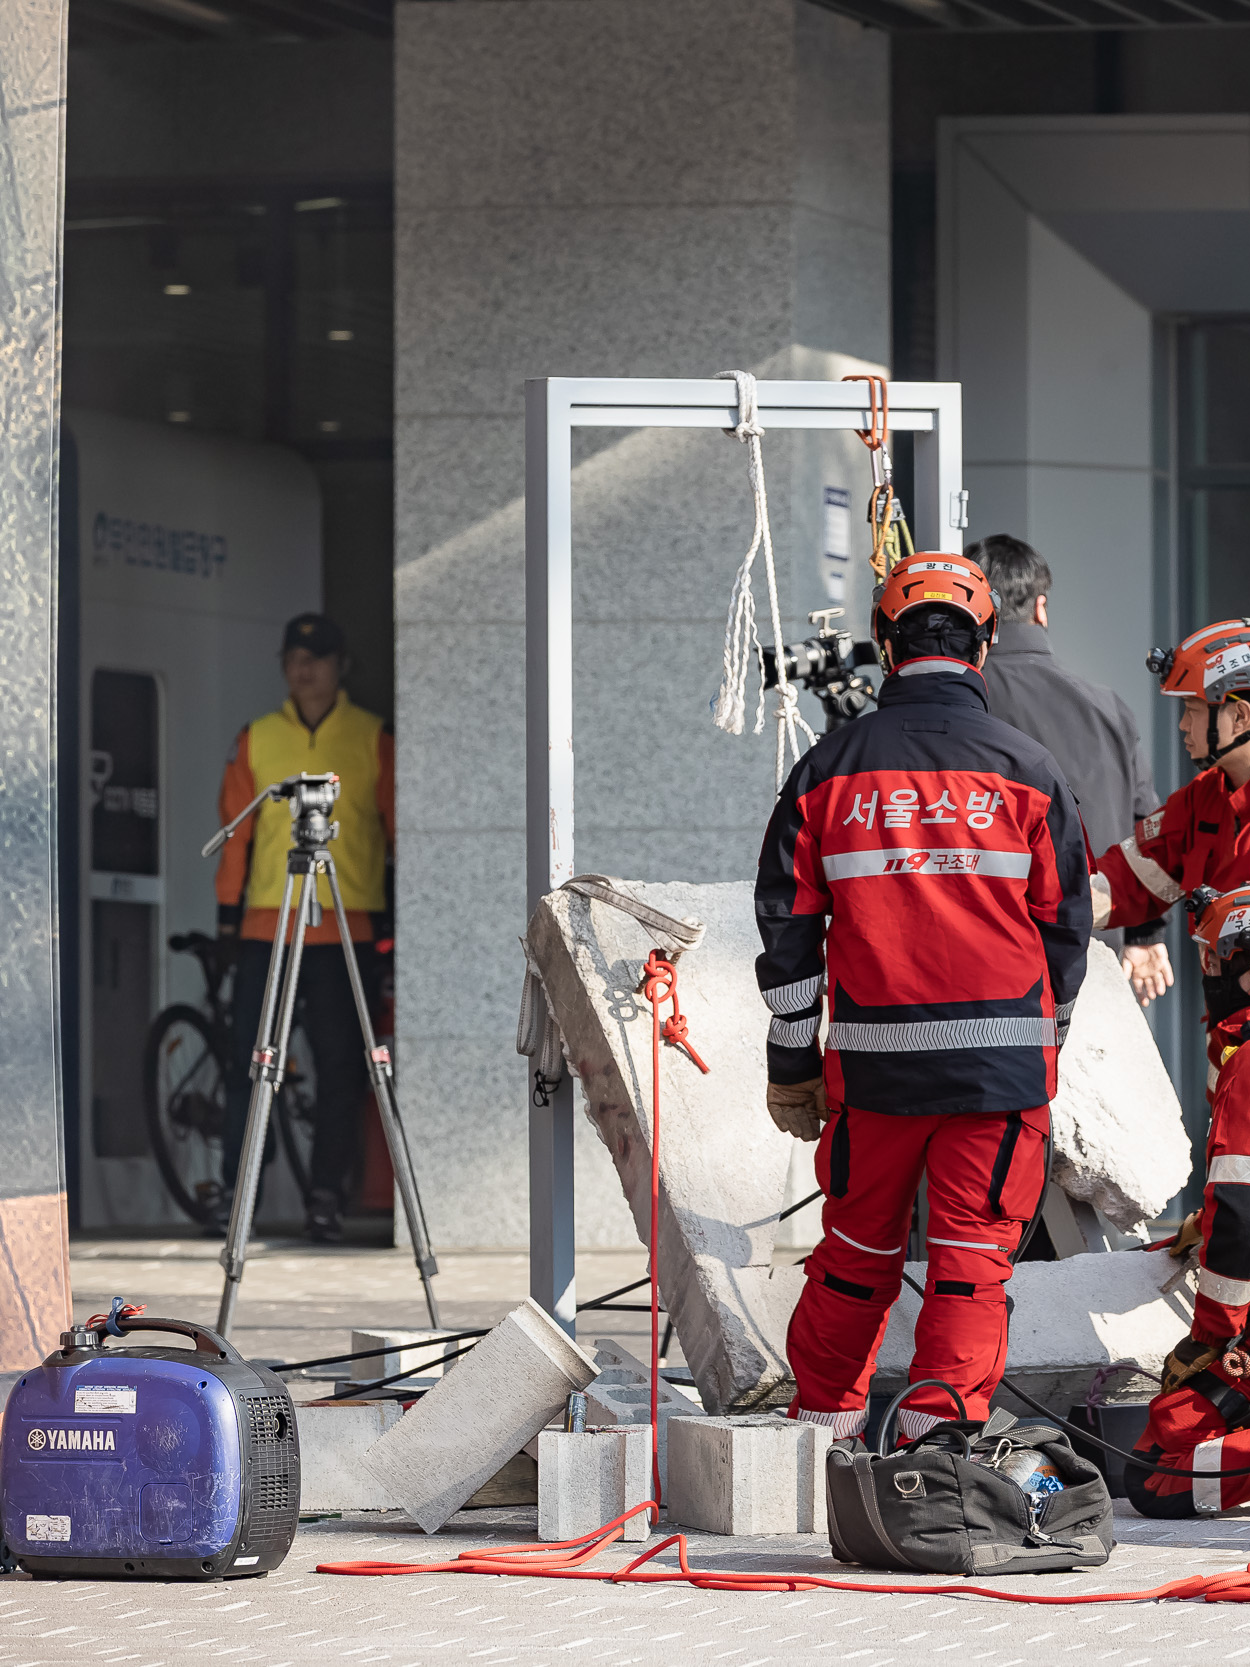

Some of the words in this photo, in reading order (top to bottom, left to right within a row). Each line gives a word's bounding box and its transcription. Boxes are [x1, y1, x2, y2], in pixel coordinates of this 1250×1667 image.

[926, 562, 953, 572] 광진
[843, 788, 1004, 831] 서울소방
[882, 851, 931, 873] 119
[933, 853, 981, 872] 구조대
[1228, 909, 1247, 923] 119
[46, 1429, 116, 1451] YAMAHA
